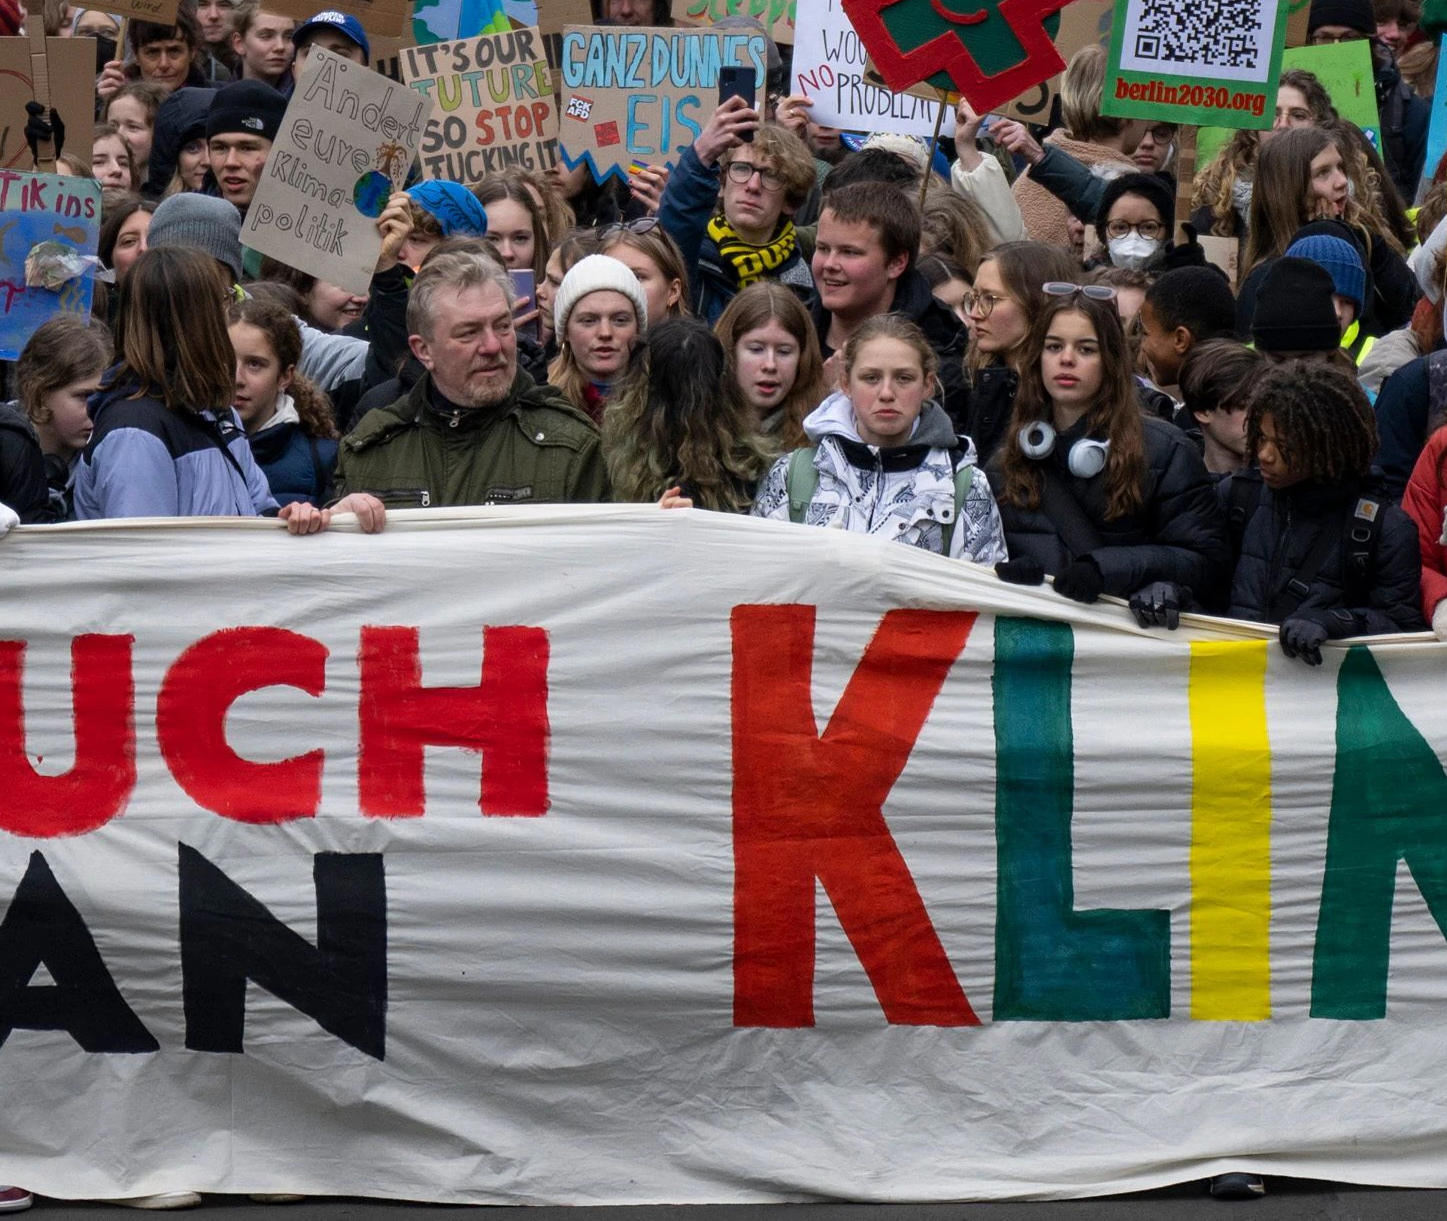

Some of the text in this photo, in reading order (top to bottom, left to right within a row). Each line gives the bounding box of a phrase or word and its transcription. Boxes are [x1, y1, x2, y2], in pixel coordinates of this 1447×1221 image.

[131, 0, 164, 14] wird
[407, 29, 537, 78] IT'S OUR
[562, 31, 767, 89] GANZ DÜNNES
[303, 52, 424, 148] Ändert
[568, 96, 592, 111] FCK
[798, 64, 834, 96] NO
[1115, 78, 1266, 115] berlin2030.org
[422, 102, 550, 153] SO STOP
[566, 107, 589, 120] AFD
[626, 95, 702, 155] EIS
[291, 118, 370, 174] eure
[536, 138, 558, 170] IT
[55, 181, 96, 219] ins
[271, 151, 354, 208] Klima-
[251, 202, 348, 257] politik
